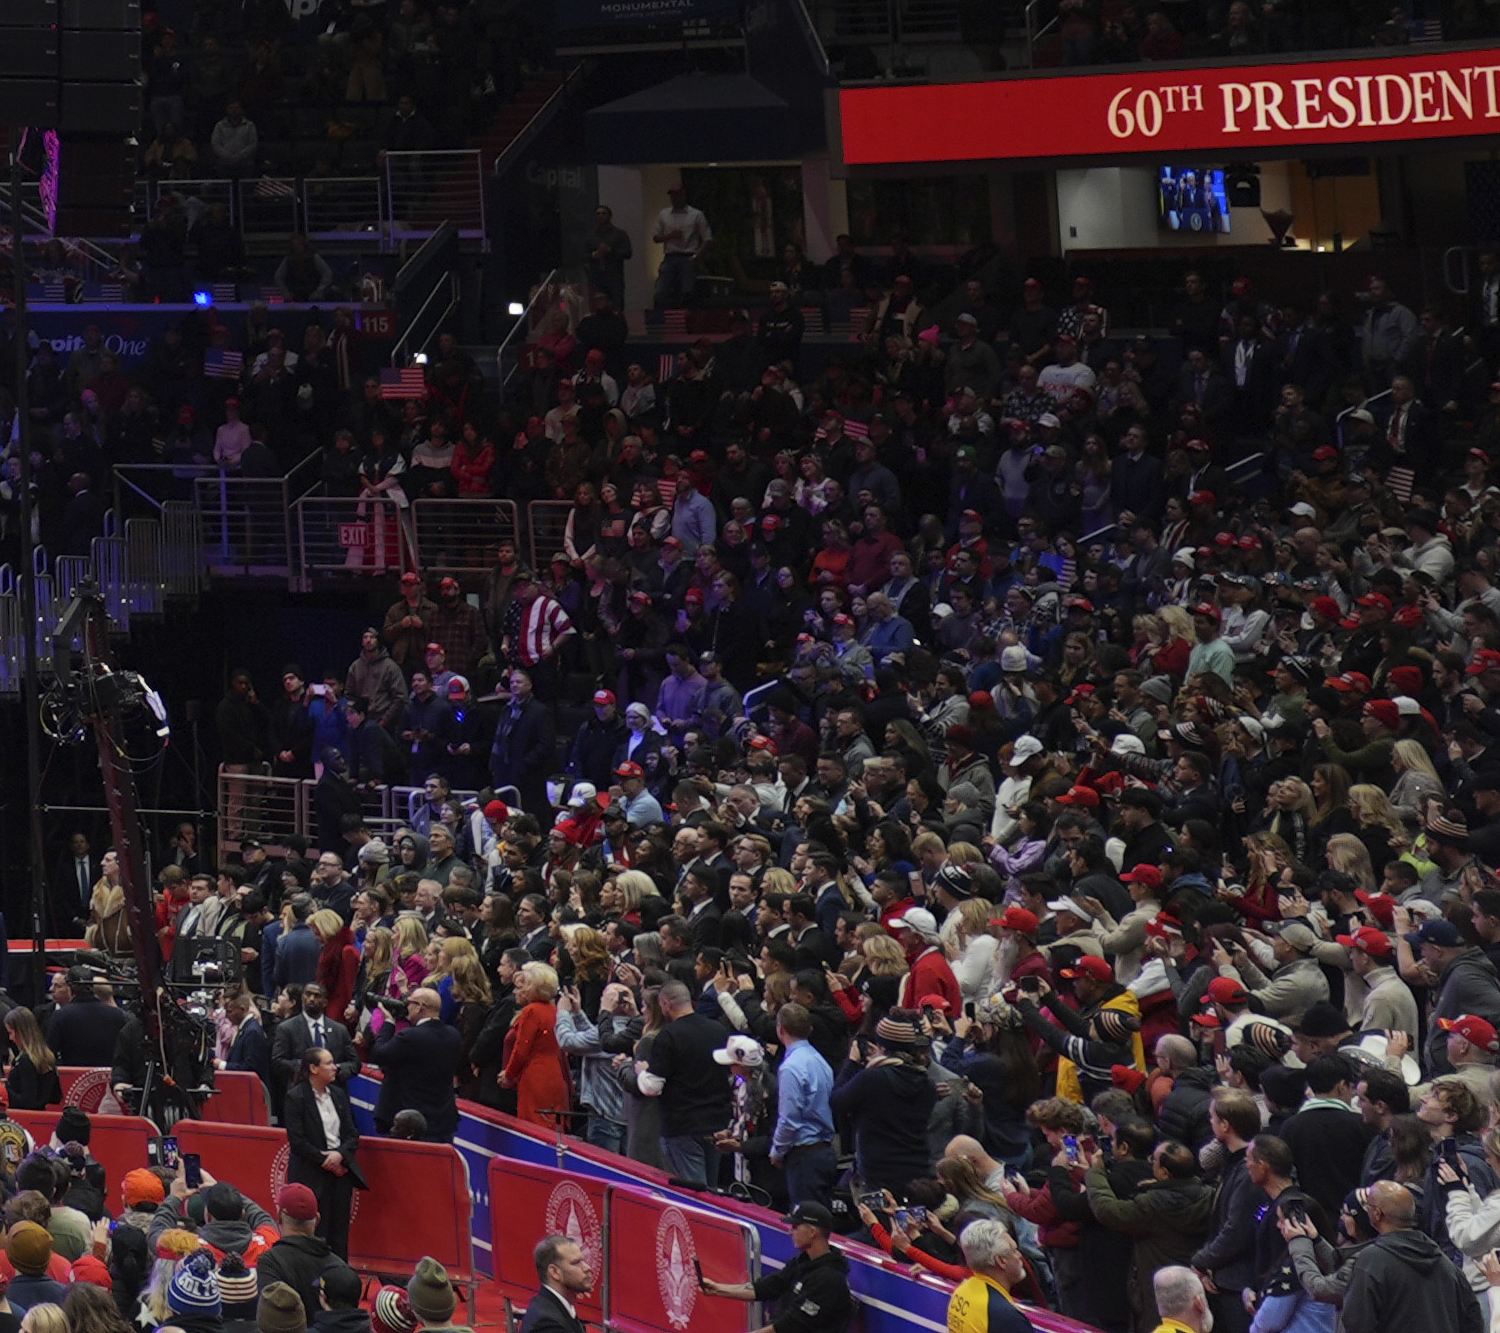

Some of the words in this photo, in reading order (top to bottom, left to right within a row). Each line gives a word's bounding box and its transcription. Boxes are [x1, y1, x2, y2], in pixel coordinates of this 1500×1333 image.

[1107, 84, 1204, 137] 60TH
[362, 316, 388, 333] 115
[104, 333, 148, 356] One
[341, 526, 366, 545] EXIT
[950, 1293, 971, 1317] CSC
